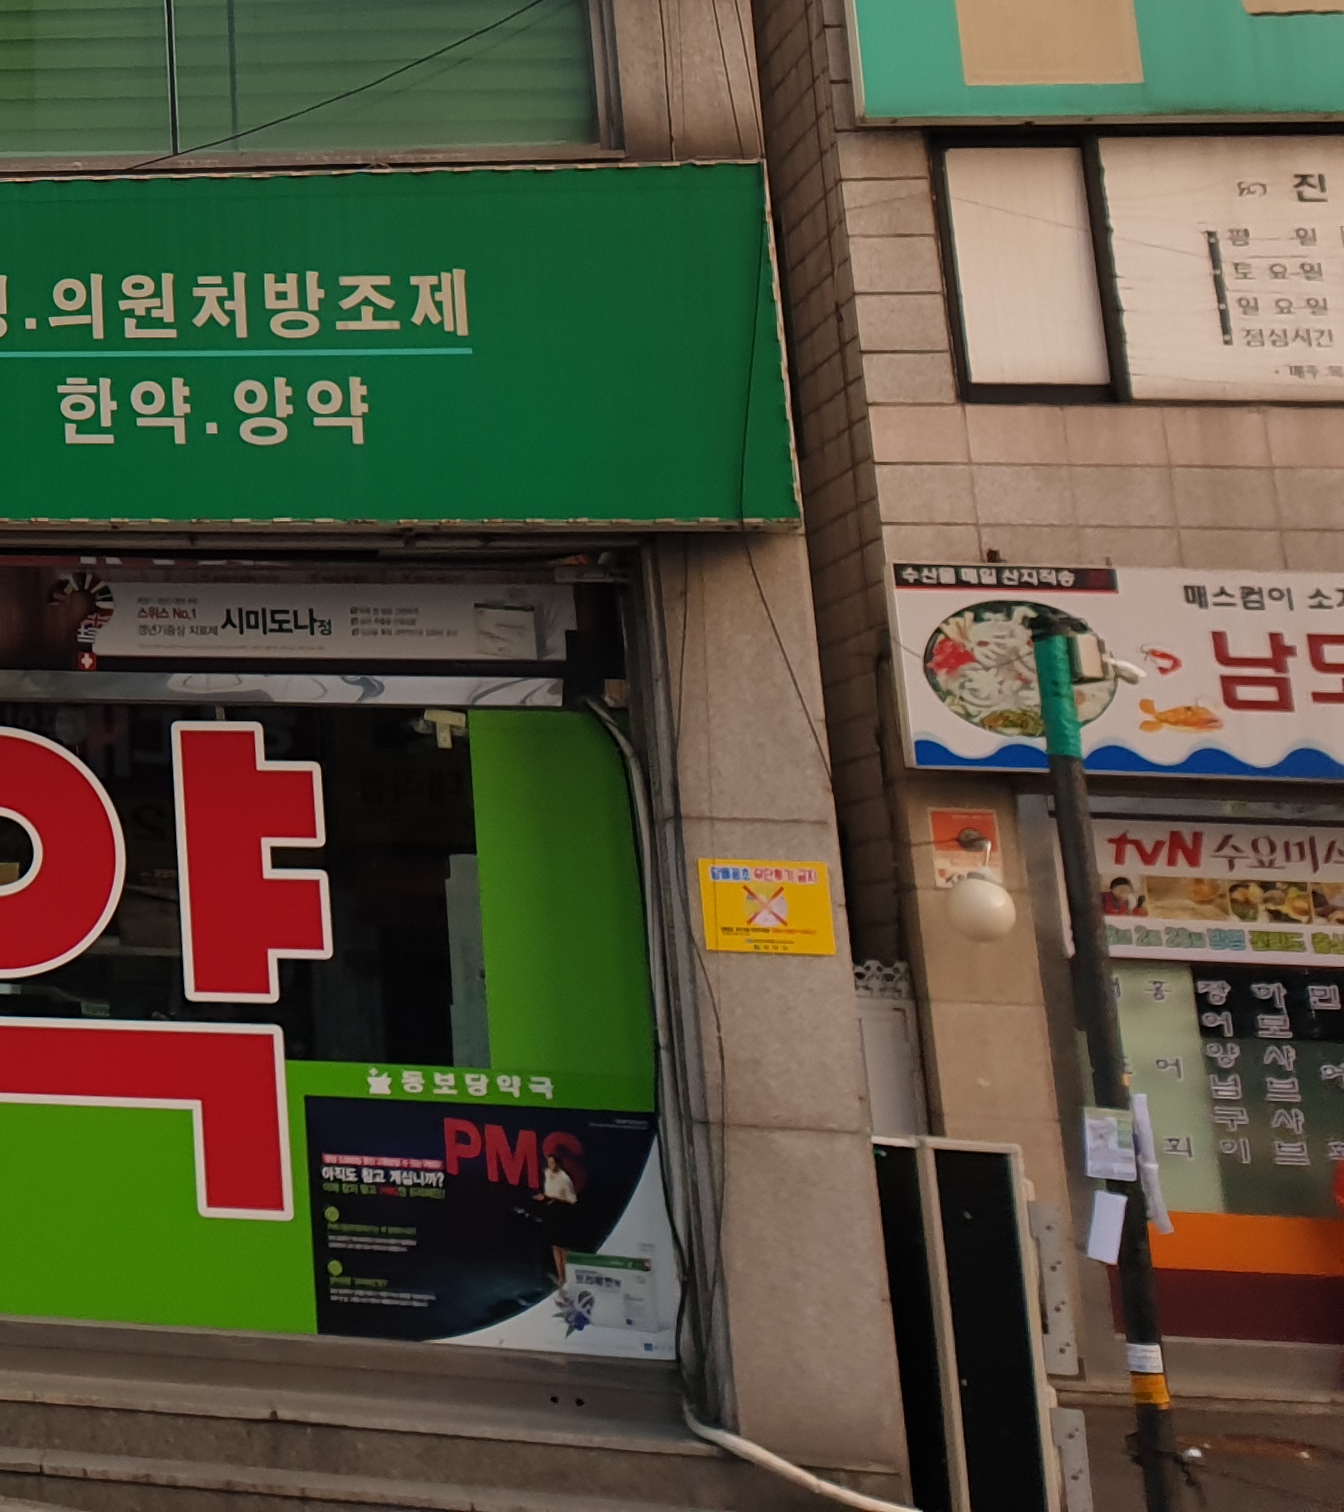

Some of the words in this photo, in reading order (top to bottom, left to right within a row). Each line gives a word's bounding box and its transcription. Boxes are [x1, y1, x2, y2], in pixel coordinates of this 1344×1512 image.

[1242, 327, 1334, 348] 점심시간
[56, 375, 370, 446] 한약.양약
[1183, 585, 1295, 611] 매스컴이
[1107, 830, 1204, 868] tvN
[399, 1069, 555, 1102] 동보당약국
[443, 1117, 585, 1192] PMS
